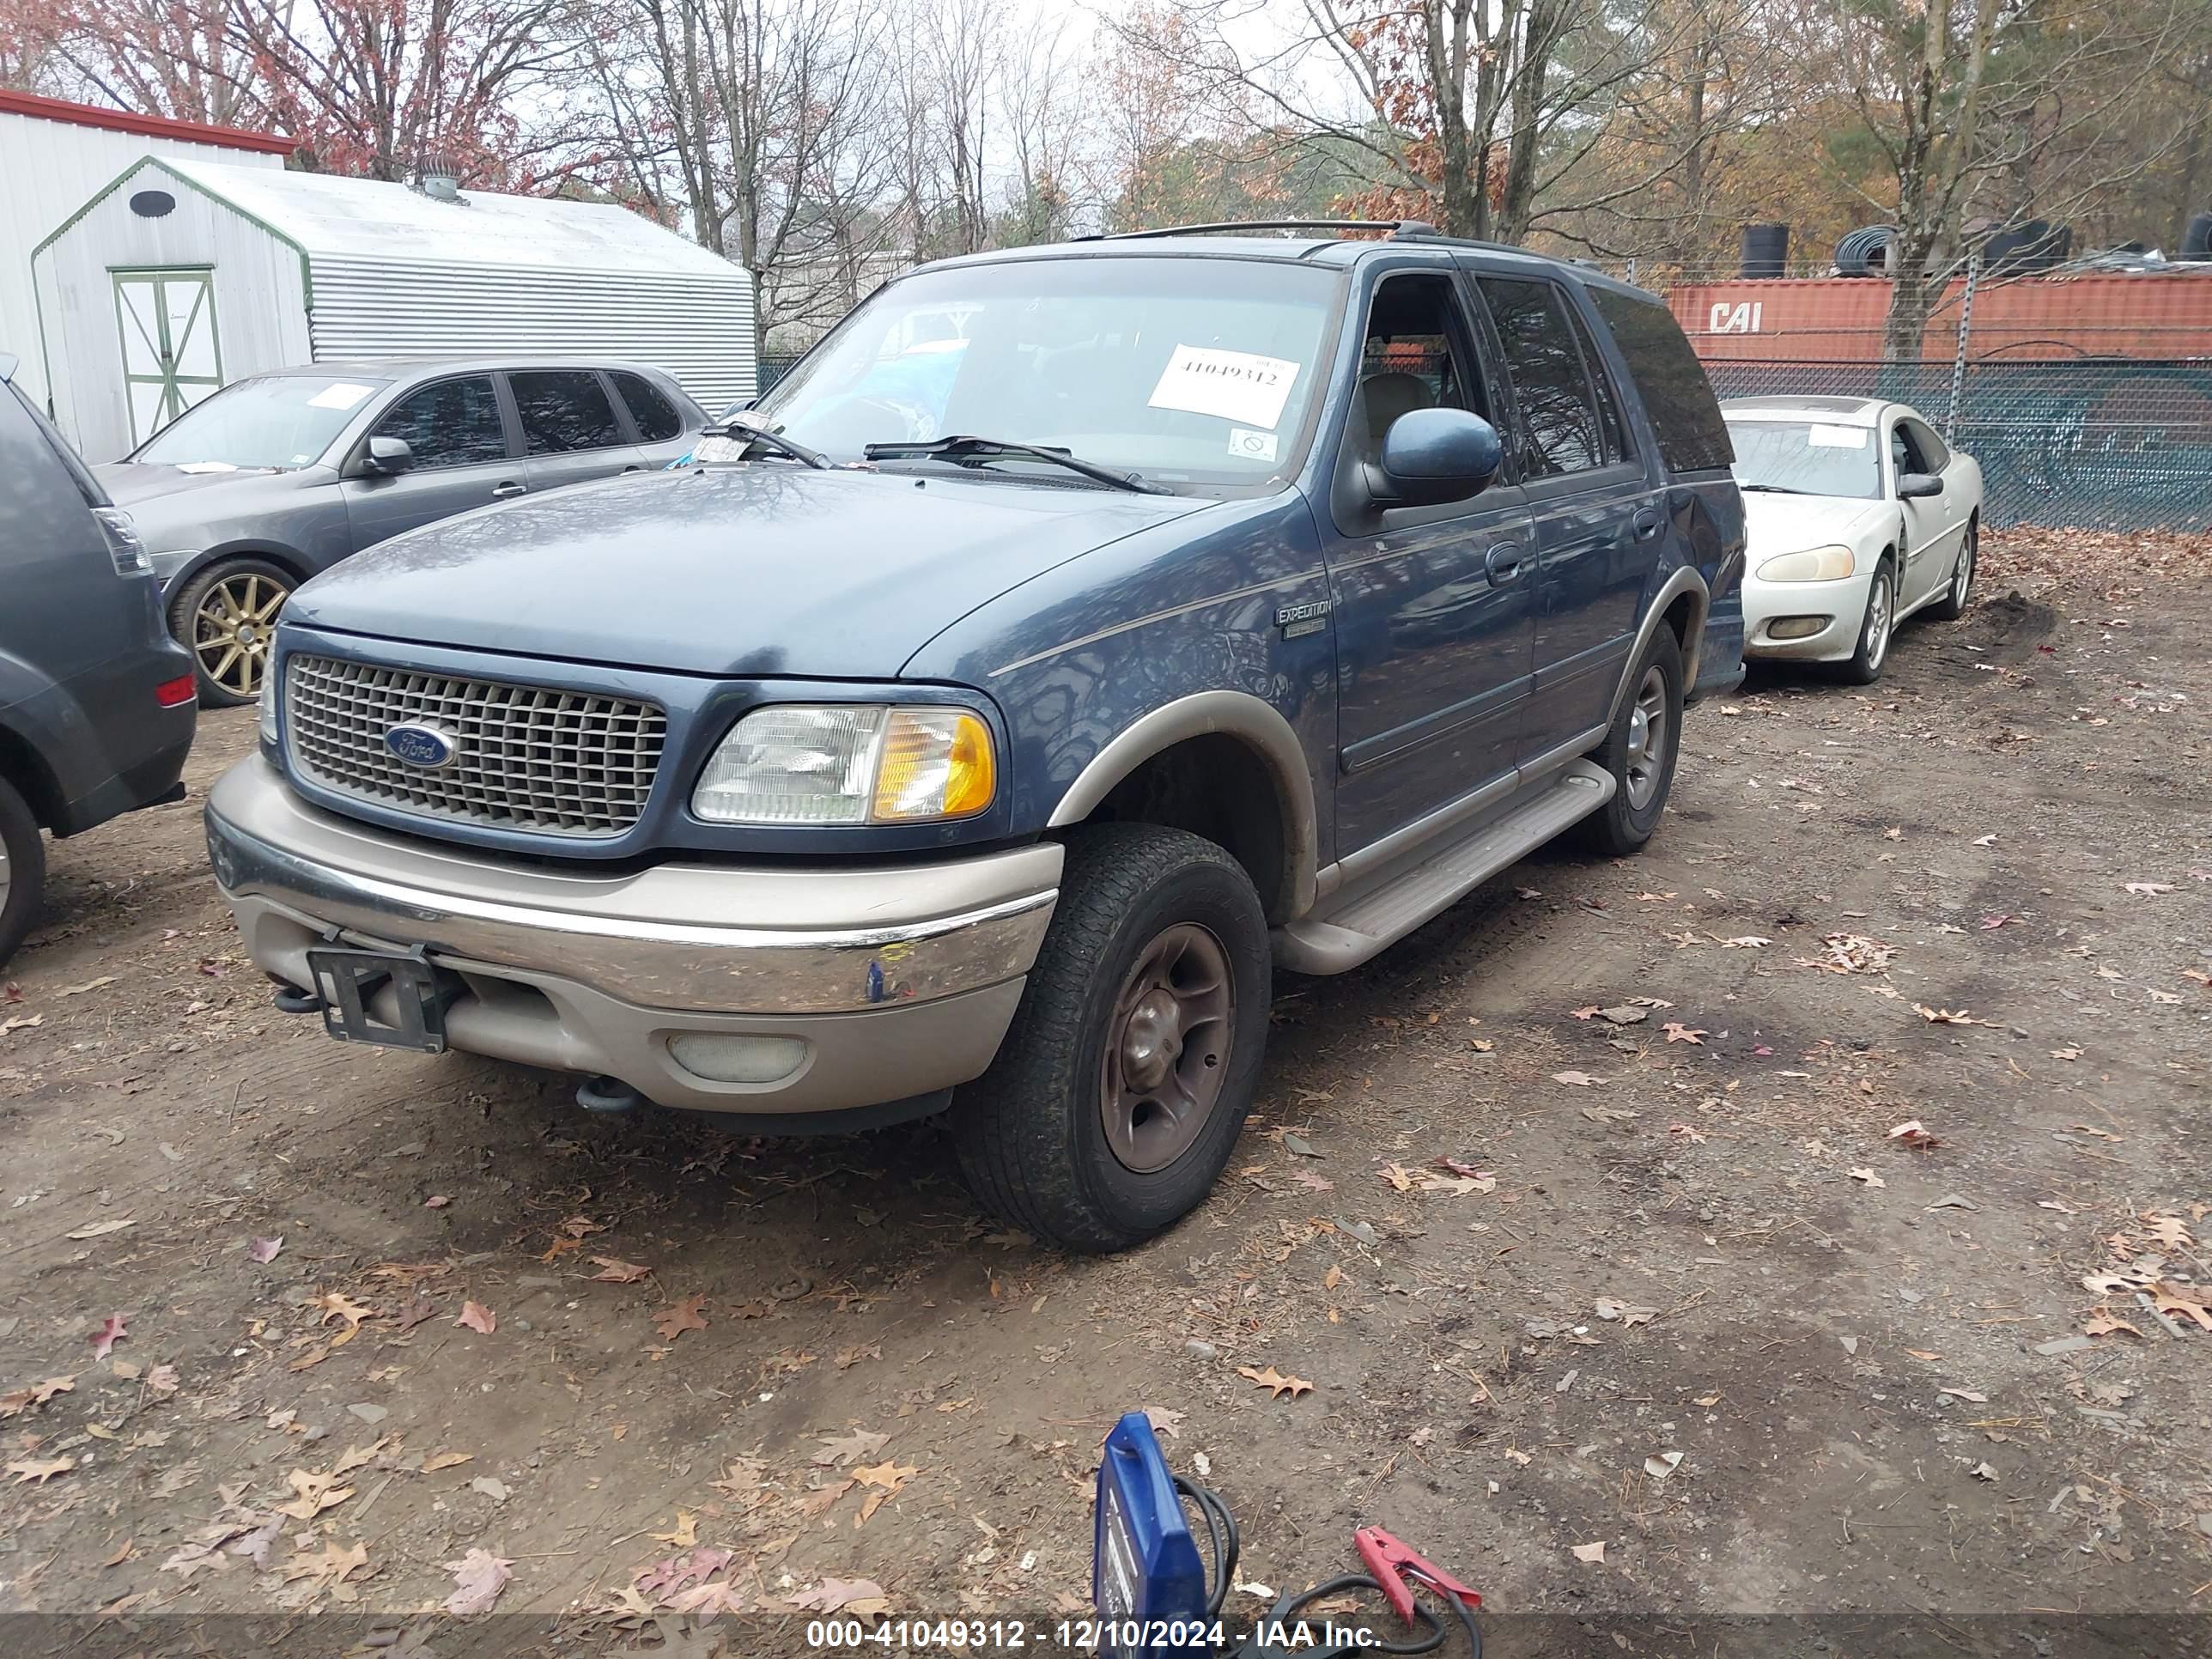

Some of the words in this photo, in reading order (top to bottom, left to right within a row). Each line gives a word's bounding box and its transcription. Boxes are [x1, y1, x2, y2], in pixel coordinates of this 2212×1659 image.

[1710, 301, 1763, 333] CAI
[1181, 362, 1278, 386] 41049312
[1279, 599, 1332, 623] EXPEDITION
[398, 732, 435, 759] Ford
